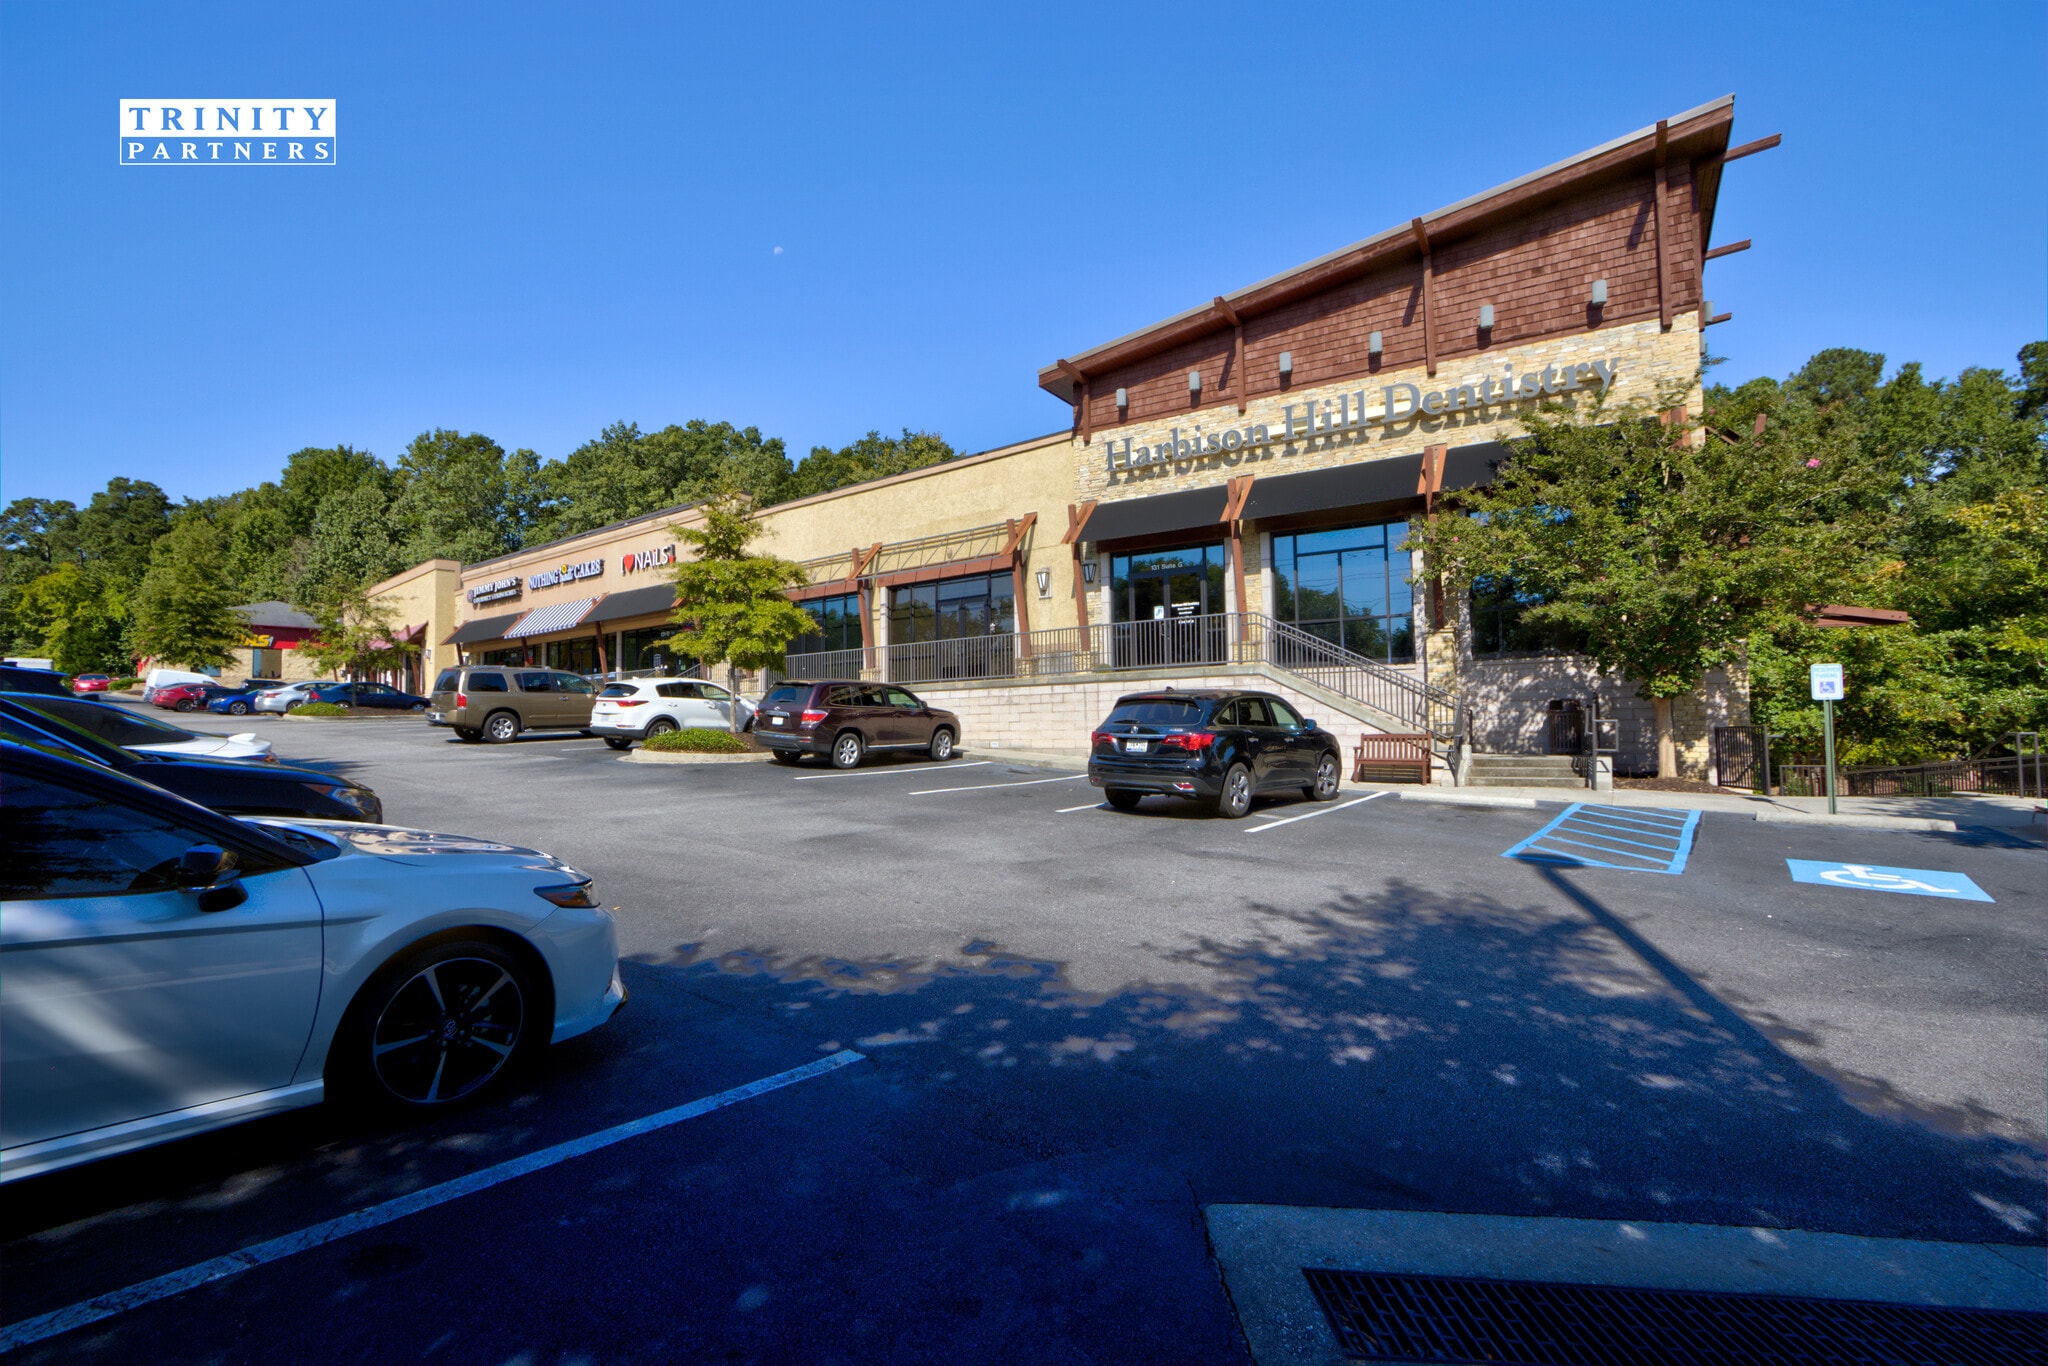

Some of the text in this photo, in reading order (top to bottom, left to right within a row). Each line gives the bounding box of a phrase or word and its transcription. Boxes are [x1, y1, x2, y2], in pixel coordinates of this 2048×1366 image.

[1104, 356, 1620, 473] Harbison Hill Dentistry
[473, 576, 517, 598] JIMMY JOHN'S
[528, 569, 560, 590] NOTHING
[573, 559, 602, 579] CAKES
